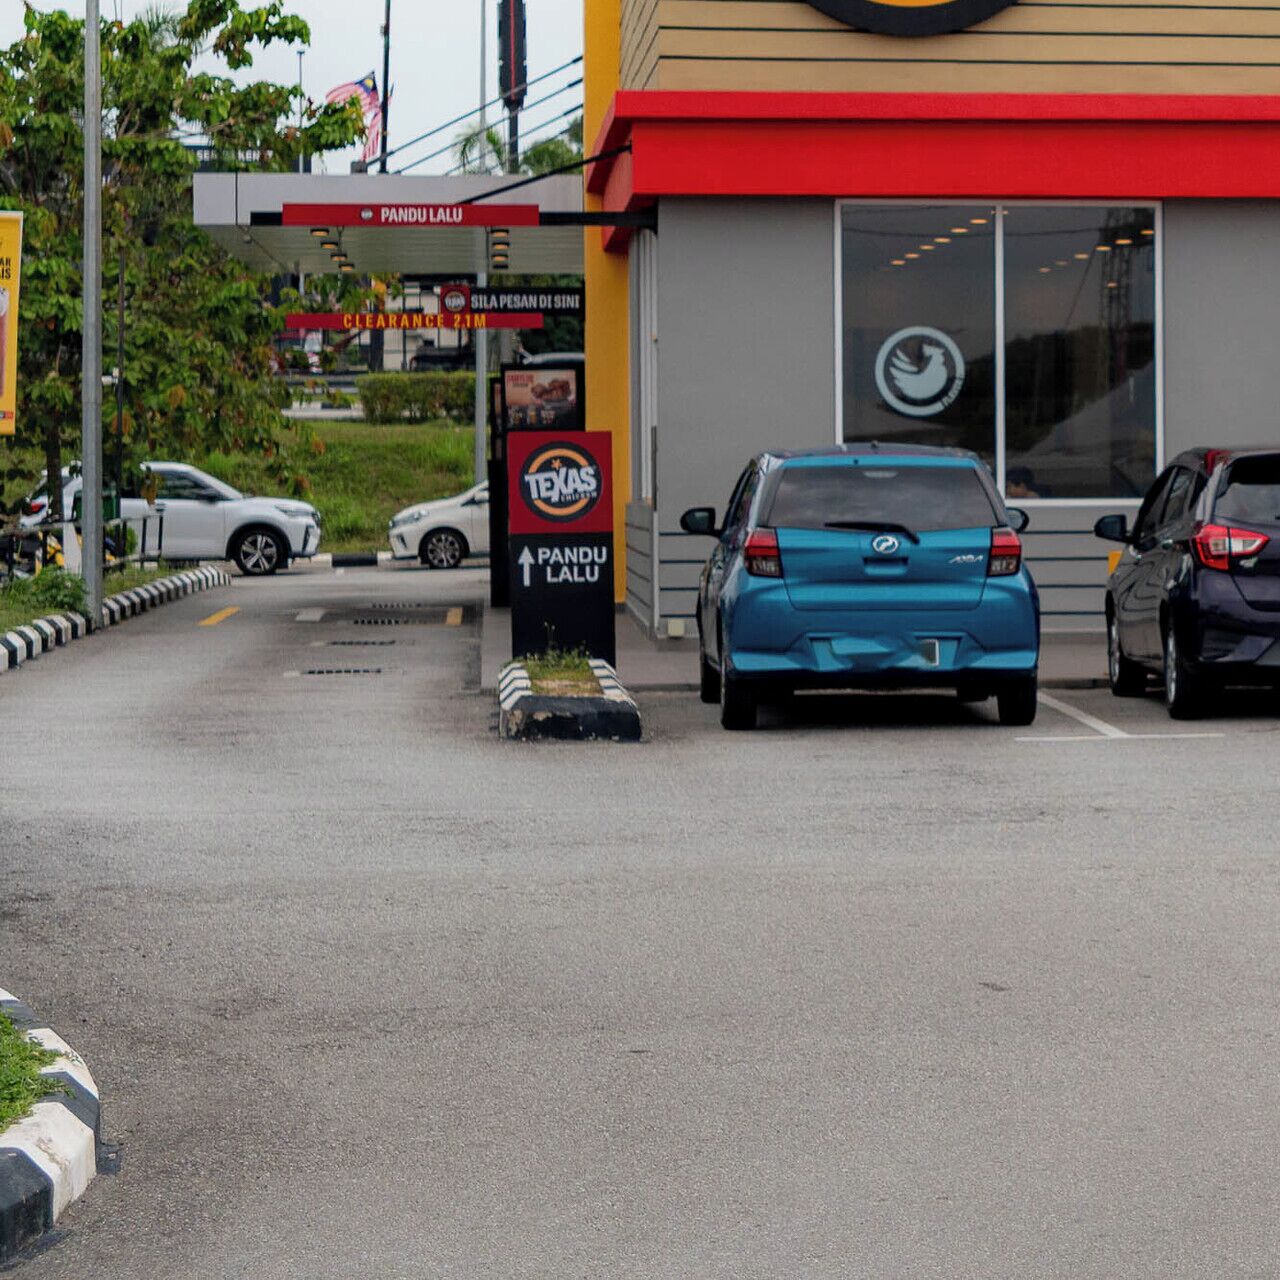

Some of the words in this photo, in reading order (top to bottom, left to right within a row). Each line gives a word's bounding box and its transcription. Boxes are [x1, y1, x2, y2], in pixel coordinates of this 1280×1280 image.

[380, 207, 427, 223] PANDU
[428, 208, 463, 223] LALU
[471, 293, 498, 310] SILA
[499, 294, 539, 310] PESAN
[539, 294, 553, 310] DI
[554, 294, 579, 310] SINI
[343, 313, 444, 329] CLEARANCE
[454, 314, 486, 328] 2.1M
[525, 466, 597, 503] TEXAS
[538, 546, 607, 565] PANDU
[546, 566, 599, 583] LALU
